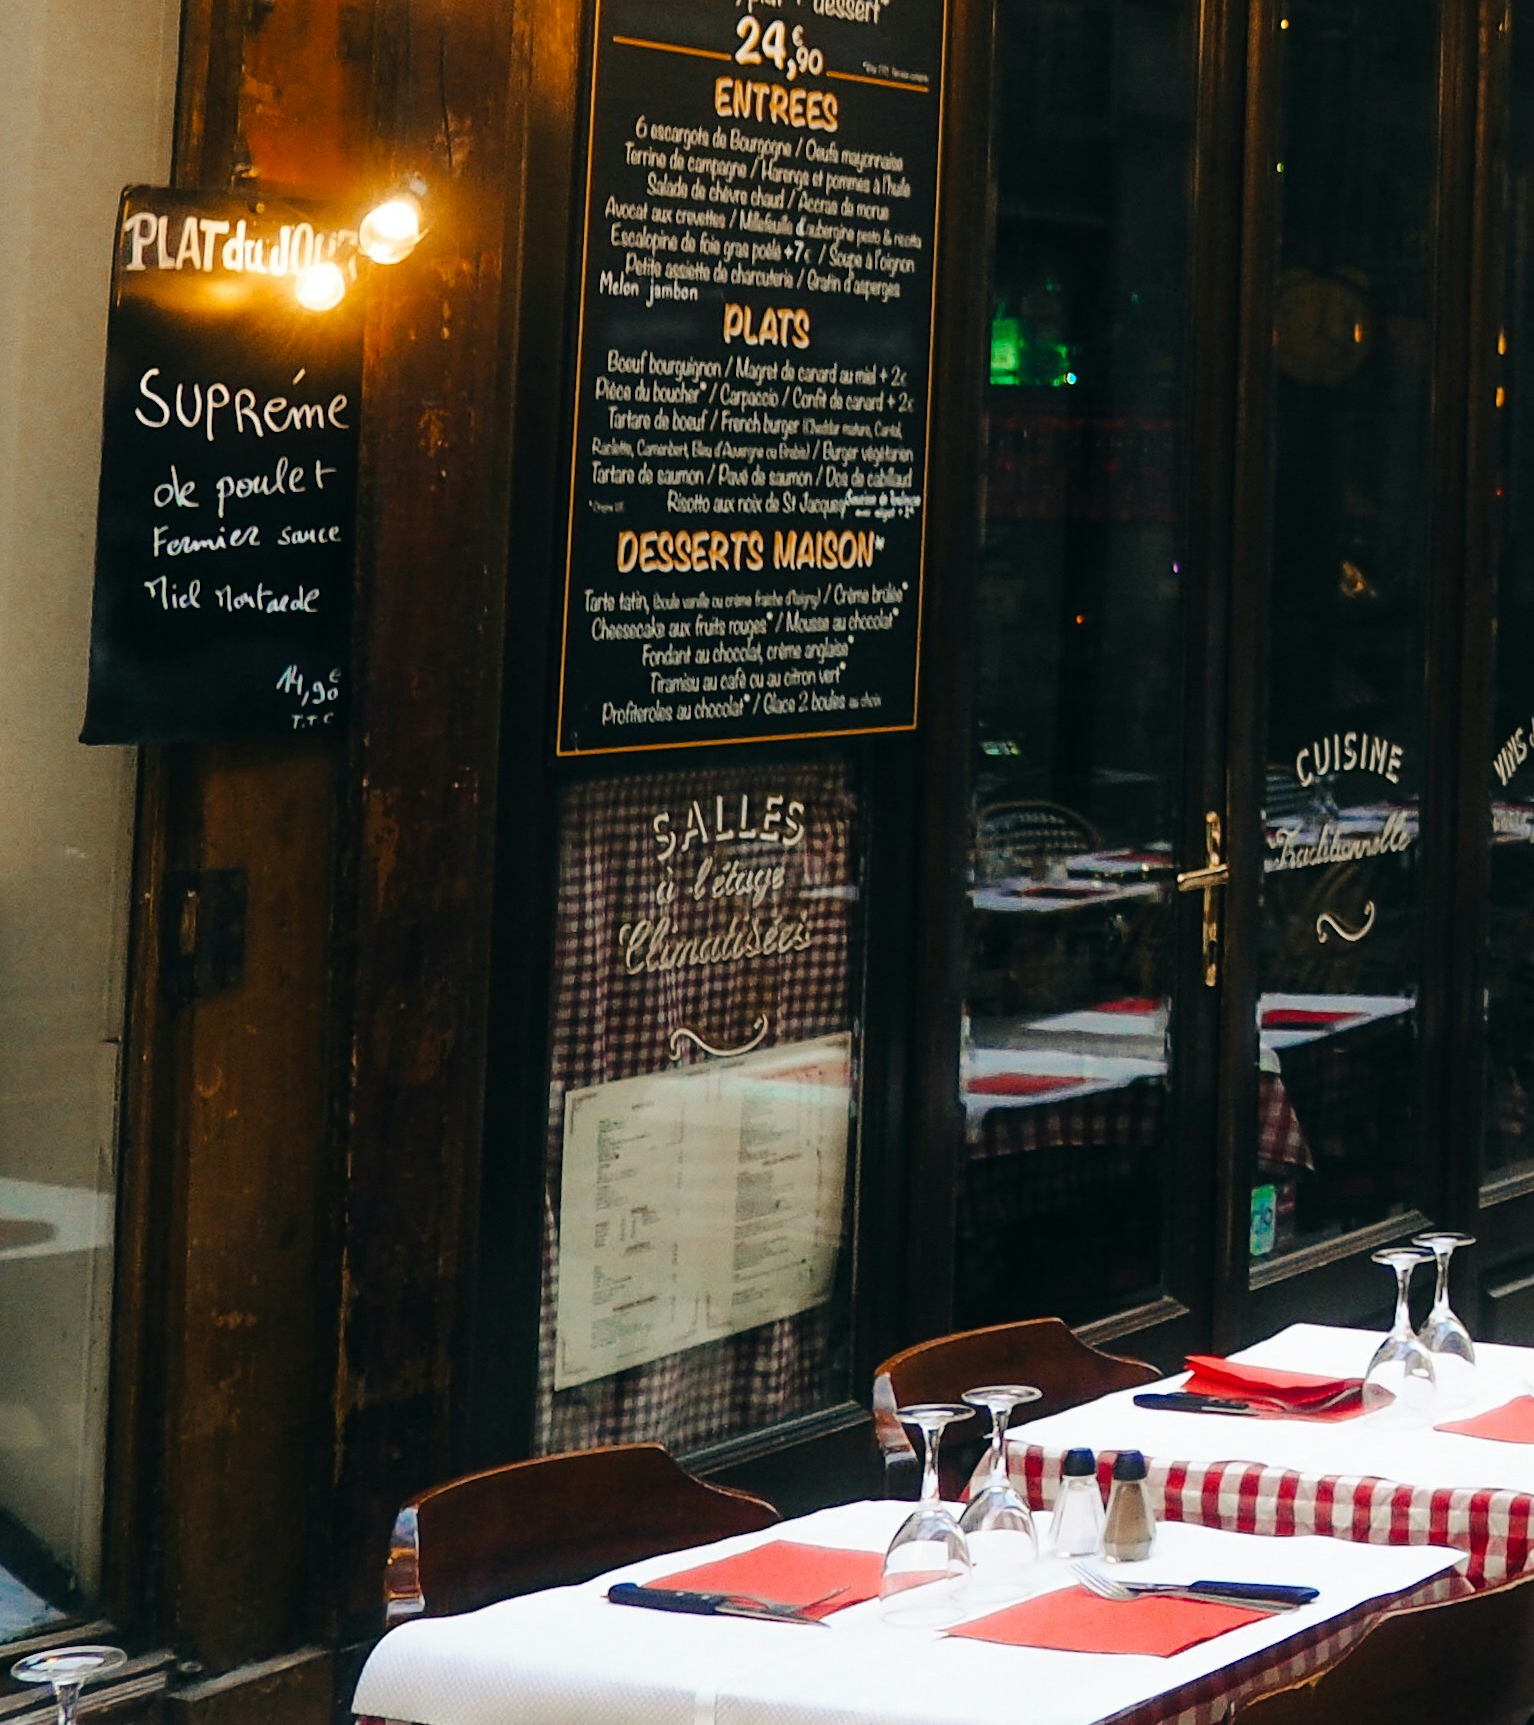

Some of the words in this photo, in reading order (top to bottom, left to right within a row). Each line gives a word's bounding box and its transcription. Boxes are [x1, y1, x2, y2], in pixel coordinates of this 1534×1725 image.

[636, 115, 647, 138] 6
[714, 75, 839, 132] ENTREES
[124, 211, 229, 273] PLAT
[222, 219, 267, 275] du
[722, 302, 810, 349] PLATS
[153, 464, 199, 509] de
[216, 457, 338, 517] poulet
[153, 525, 261, 558] Fermier
[277, 521, 342, 546] sauce
[617, 529, 765, 573] DESSERTS
[144, 574, 201, 612] Miel
[1296, 731, 1404, 788] CUISINE
[1493, 727, 1527, 786] VINS
[654, 794, 806, 863] SALLES
[1275, 810, 1410, 871] Traditionnelle
[654, 865, 678, 906] à
[691, 855, 786, 910] l'étage
